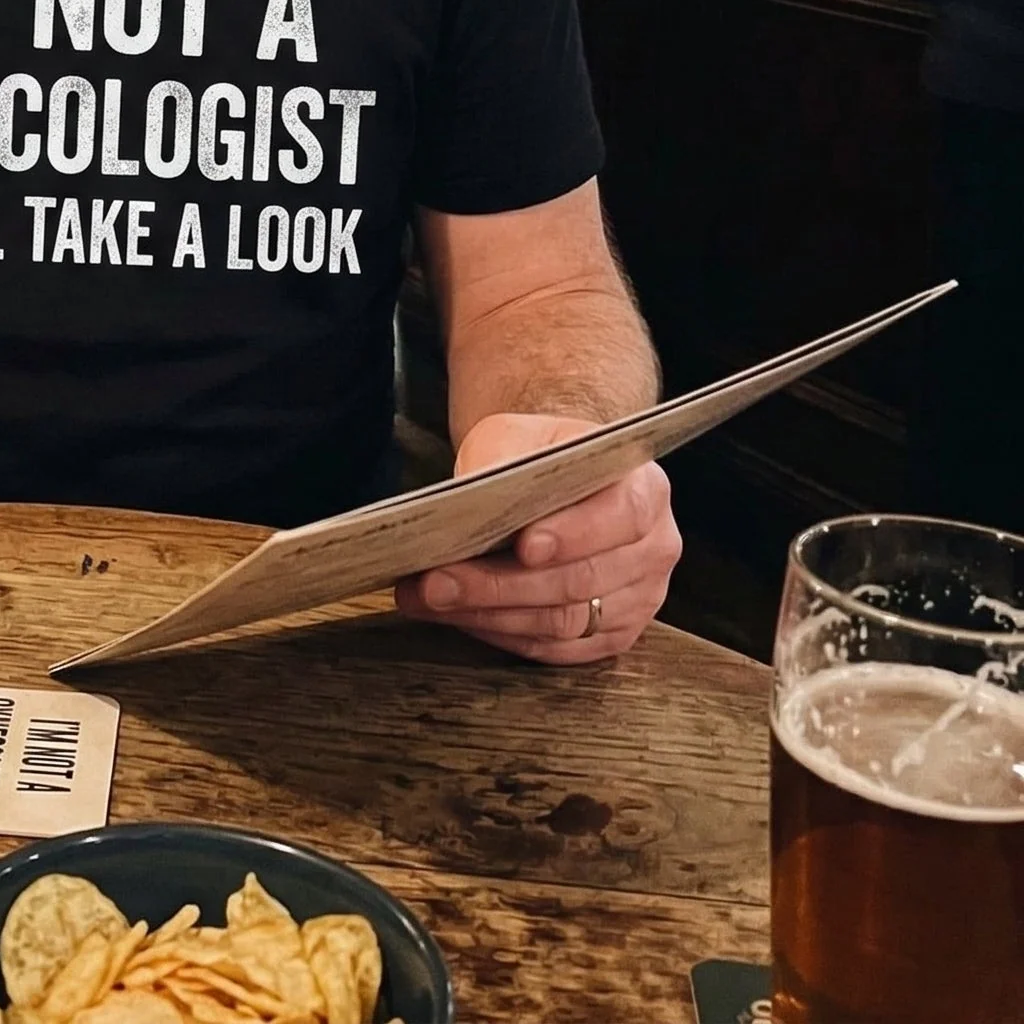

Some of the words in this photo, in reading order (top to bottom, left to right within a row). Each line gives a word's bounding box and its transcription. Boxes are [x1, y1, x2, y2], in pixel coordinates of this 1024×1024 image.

[23, 195, 156, 267] TAKE
[172, 202, 206, 269] A
[226, 204, 363, 275] LOOK
[19, 745, 78, 780] NOT
[16, 781, 72, 793] A
